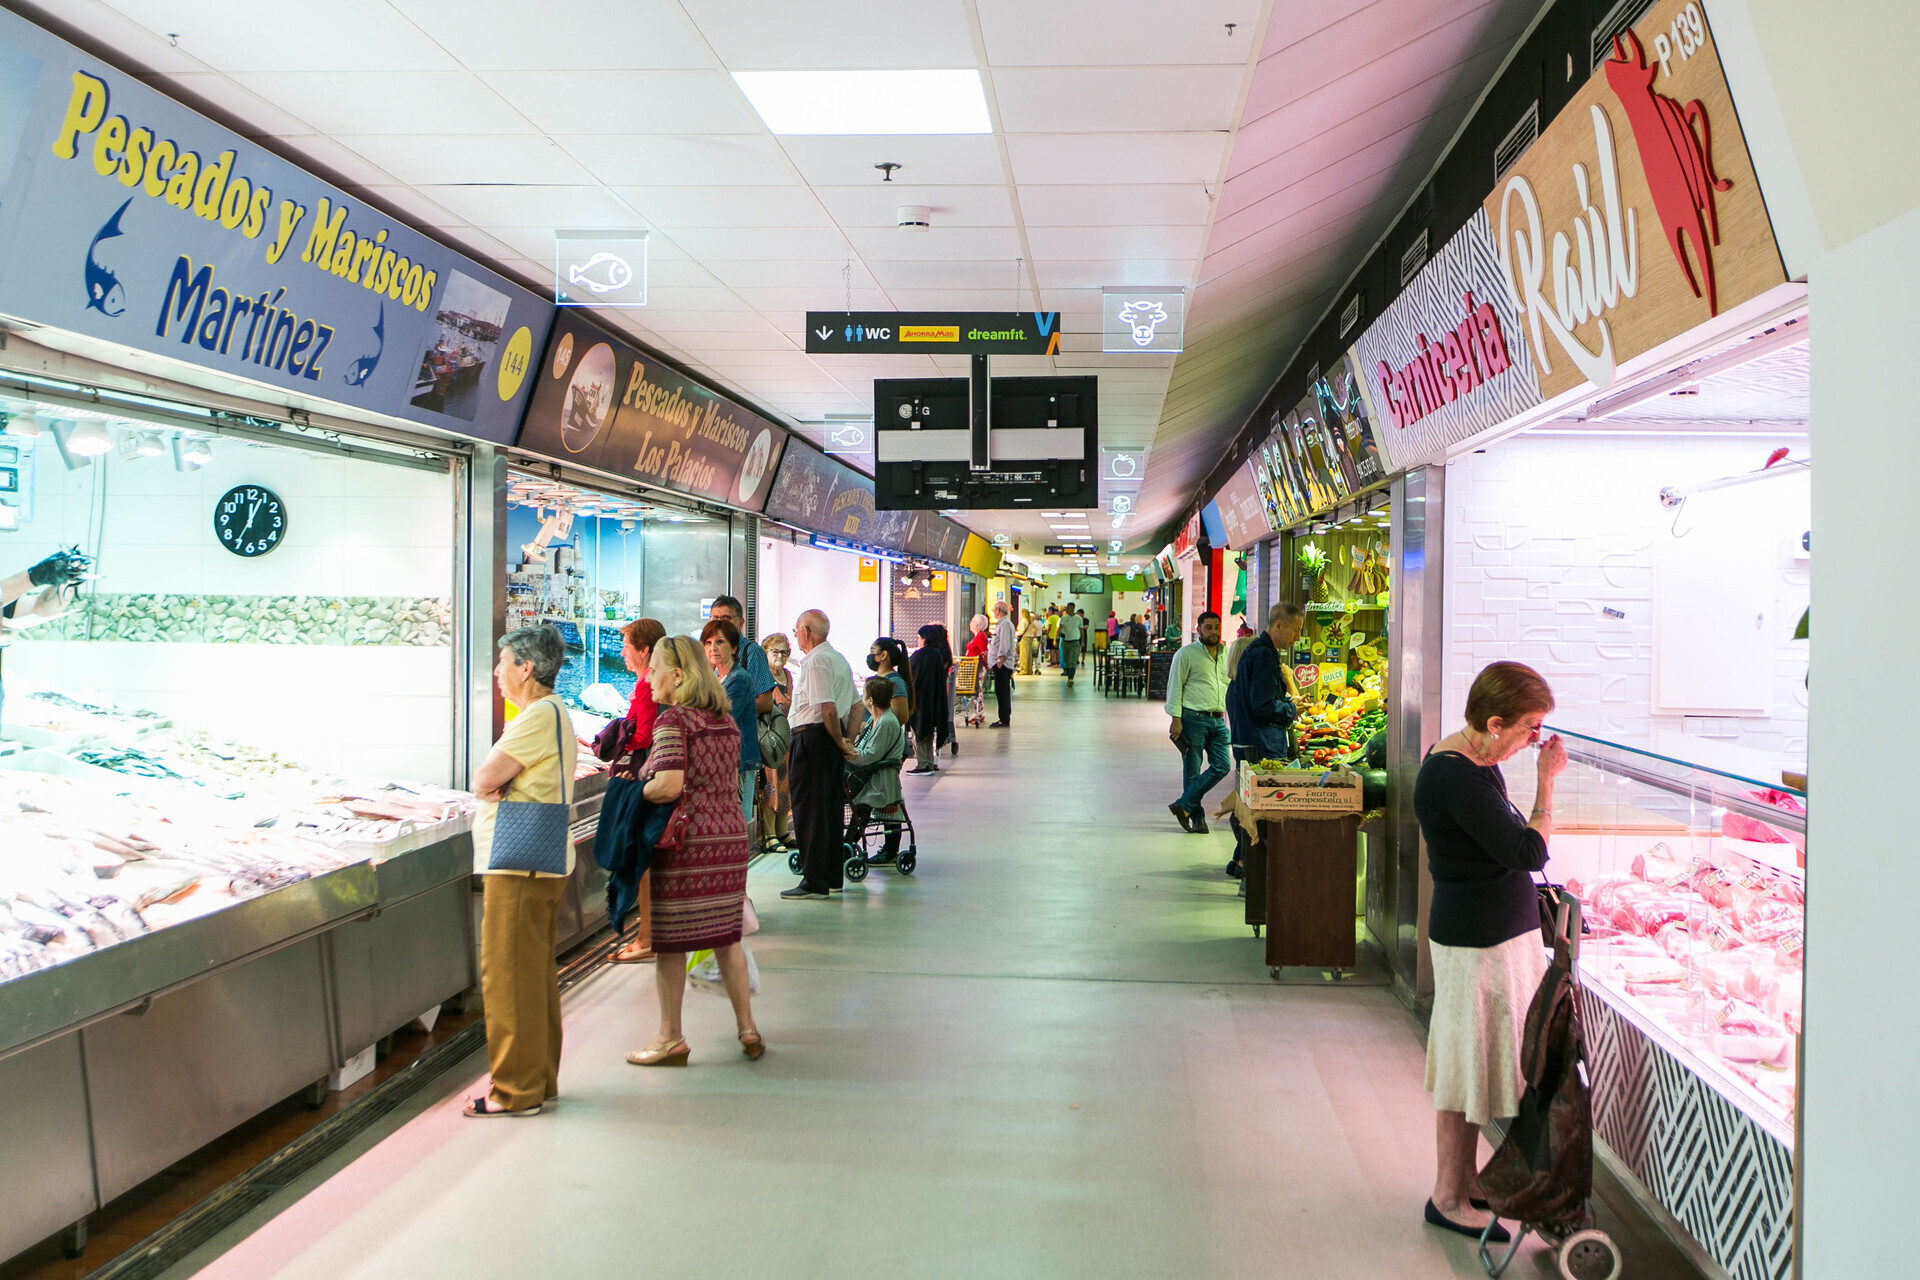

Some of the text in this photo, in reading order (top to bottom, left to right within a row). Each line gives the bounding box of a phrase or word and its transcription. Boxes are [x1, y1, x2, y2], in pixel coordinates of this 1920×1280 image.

[1654, 1, 1708, 78] P 139
[52, 69, 438, 313] Pescados y Mariscos
[1500, 103, 1641, 390] Raúl
[156, 254, 335, 382] Martínez
[865, 327, 891, 340] WC
[504, 350, 525, 376] 144
[556, 346, 572, 367] 145
[1377, 291, 1513, 430] Carnicería
[622, 360, 750, 454] Pescados y Mariscos
[633, 430, 716, 491] Los Palacios
[234, 492, 244, 504] 11
[246, 488, 259, 501] 12
[262, 492, 268, 504] 1
[223, 501, 237, 514] 10
[268, 501, 279, 514] 2
[220, 514, 230, 526] 9
[272, 516, 282, 528] 3
[223, 528, 233, 540] 8
[267, 530, 277, 542] 4
[234, 538, 243, 550] 7
[245, 541, 255, 554] 6
[257, 539, 267, 551] 5
[1298, 666, 1316, 677] Pink
[1323, 670, 1344, 682] DULCE
